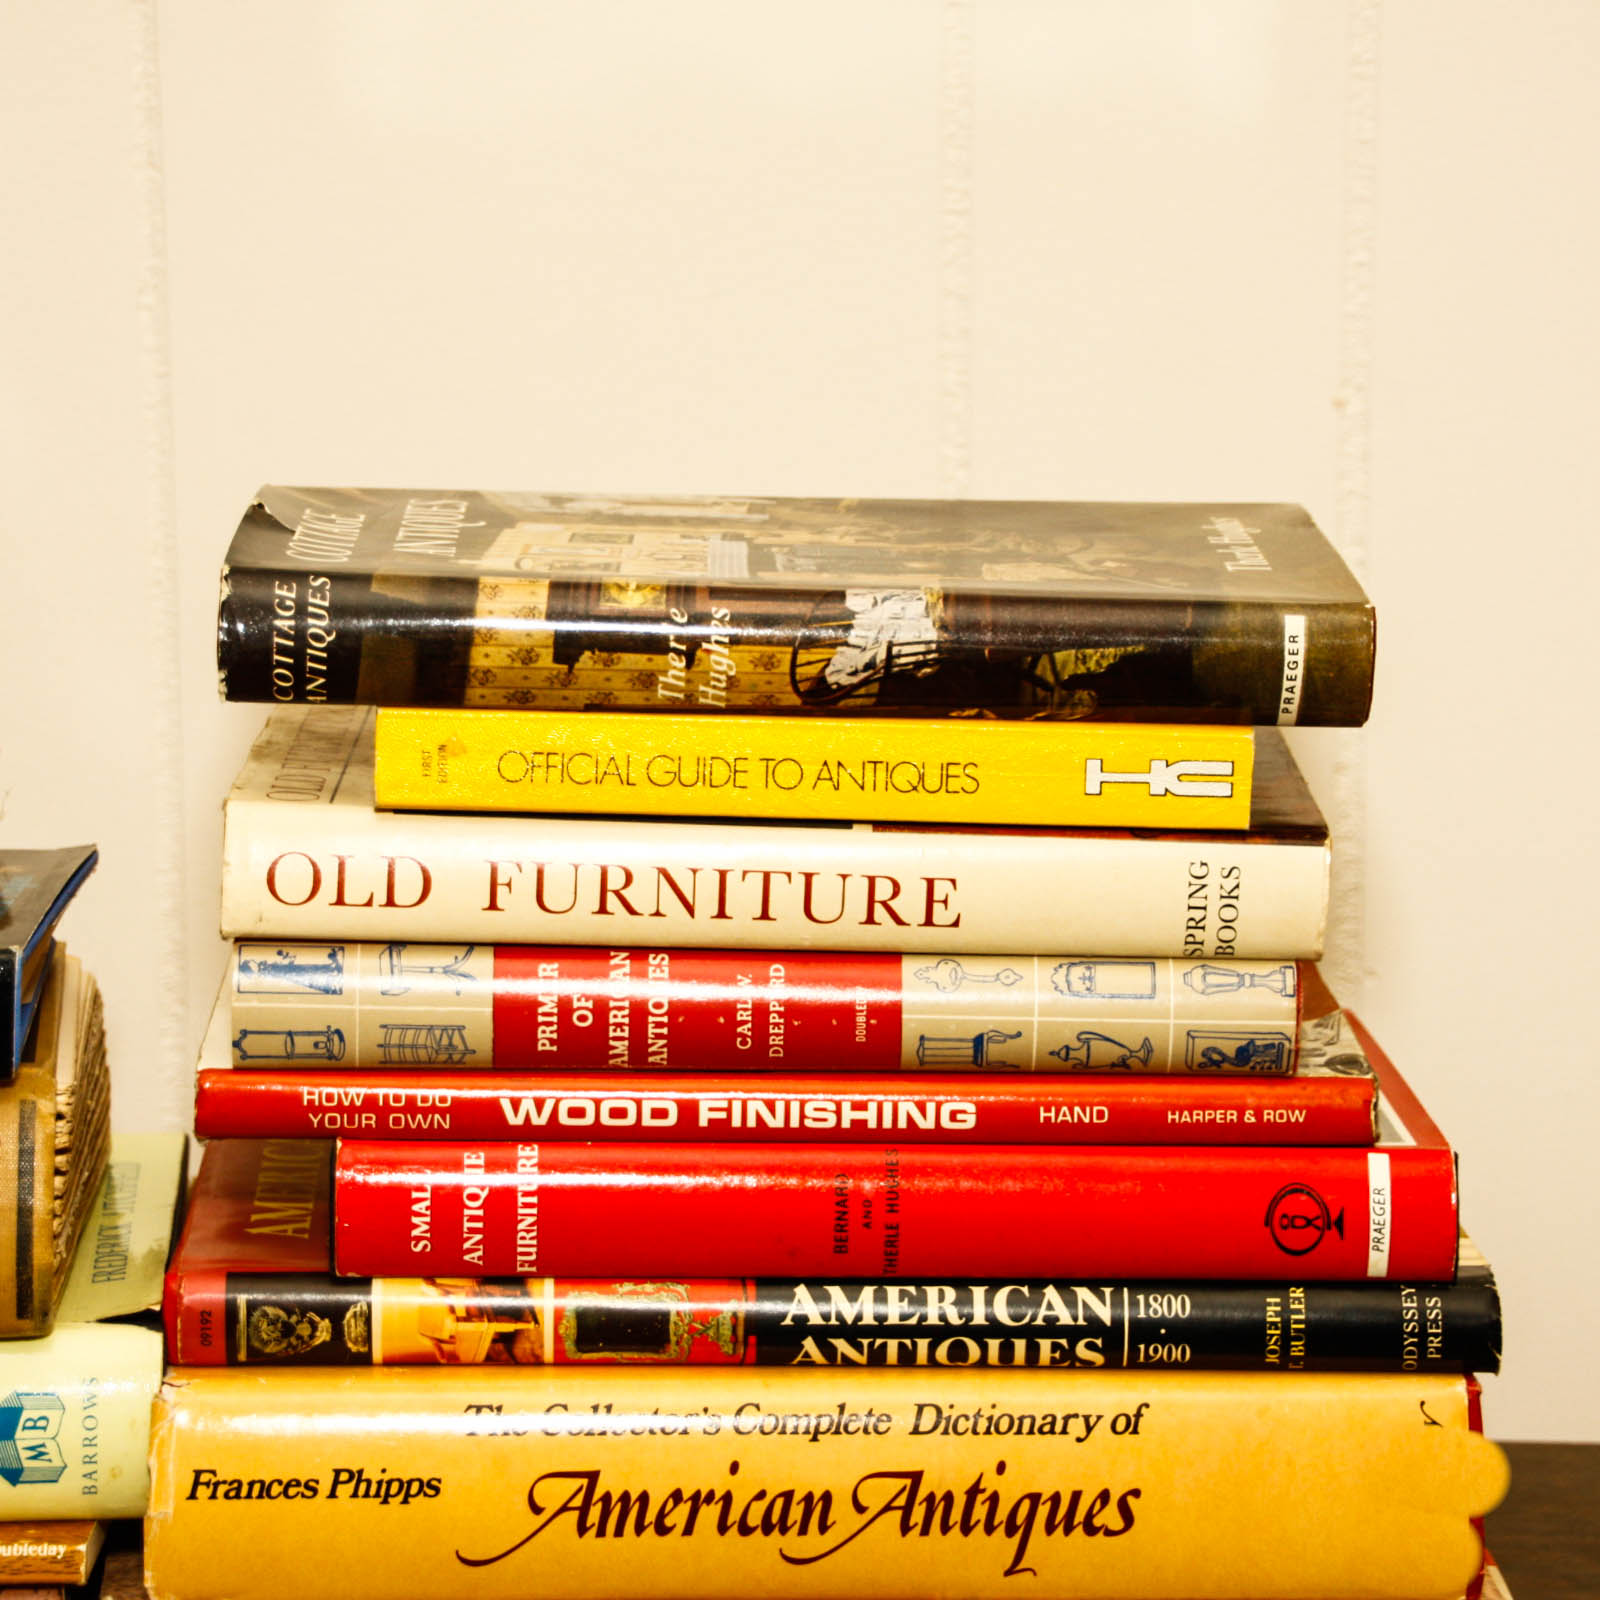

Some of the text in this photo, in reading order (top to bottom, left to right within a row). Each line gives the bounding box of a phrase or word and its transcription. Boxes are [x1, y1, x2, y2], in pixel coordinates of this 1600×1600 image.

[286, 508, 366, 562] COTTAGE
[393, 498, 487, 557] ANTIQUES
[272, 580, 297, 701] COTTAGE
[306, 574, 336, 704] ANTIQUES
[657, 607, 688, 699] There
[698, 606, 737, 708] Hughes
[1281, 633, 1300, 714] PRAEGER
[498, 750, 980, 795] OFFICIAL GUIDE TO ANTIQUES
[266, 850, 962, 930] OLD FURNITURE
[1183, 859, 1210, 957] SPRING
[1214, 865, 1242, 956] BOOKS
[537, 962, 559, 1051] PRIMR
[572, 993, 594, 1027] OF
[648, 953, 670, 1065] ANTIQES
[736, 998, 753, 1049] CARL
[769, 963, 786, 1057] DREPPRD
[855, 986, 868, 1042] DOUBLE
[303, 1087, 453, 1108] HOW TO DO
[308, 1113, 451, 1130] YOUR OWN
[500, 1096, 978, 1131] WOOD FINISHING
[1039, 1105, 1109, 1125] HAND
[1167, 1108, 1307, 1124] HARPER & ROW
[516, 1143, 539, 1273] FURNITURE
[833, 1173, 849, 1255] BERNARD
[862, 1199, 873, 1230] AND
[1371, 1186, 1386, 1253] PRAEGER
[882, 1223, 900, 1276] THERLE
[200, 1310, 212, 1347] 09192
[780, 1283, 1114, 1327] AMERICAN
[1136, 1293, 1192, 1319] 1800
[1265, 1297, 1282, 1364] JOSEPH
[1288, 1286, 1305, 1356] BUTLER
[1401, 1284, 1419, 1371] ODYSSEY
[1426, 1296, 1443, 1359] PRESS
[790, 1334, 1107, 1367] ANTIQUES
[1136, 1343, 1192, 1364] 1900
[82, 1377, 99, 1496] BARROWS
[463, 1402, 1151, 1445] Th Clltor's Complete Dictionary of
[185, 1467, 443, 1505] Frances Phipps
[455, 1459, 1143, 1577] American Antiques
